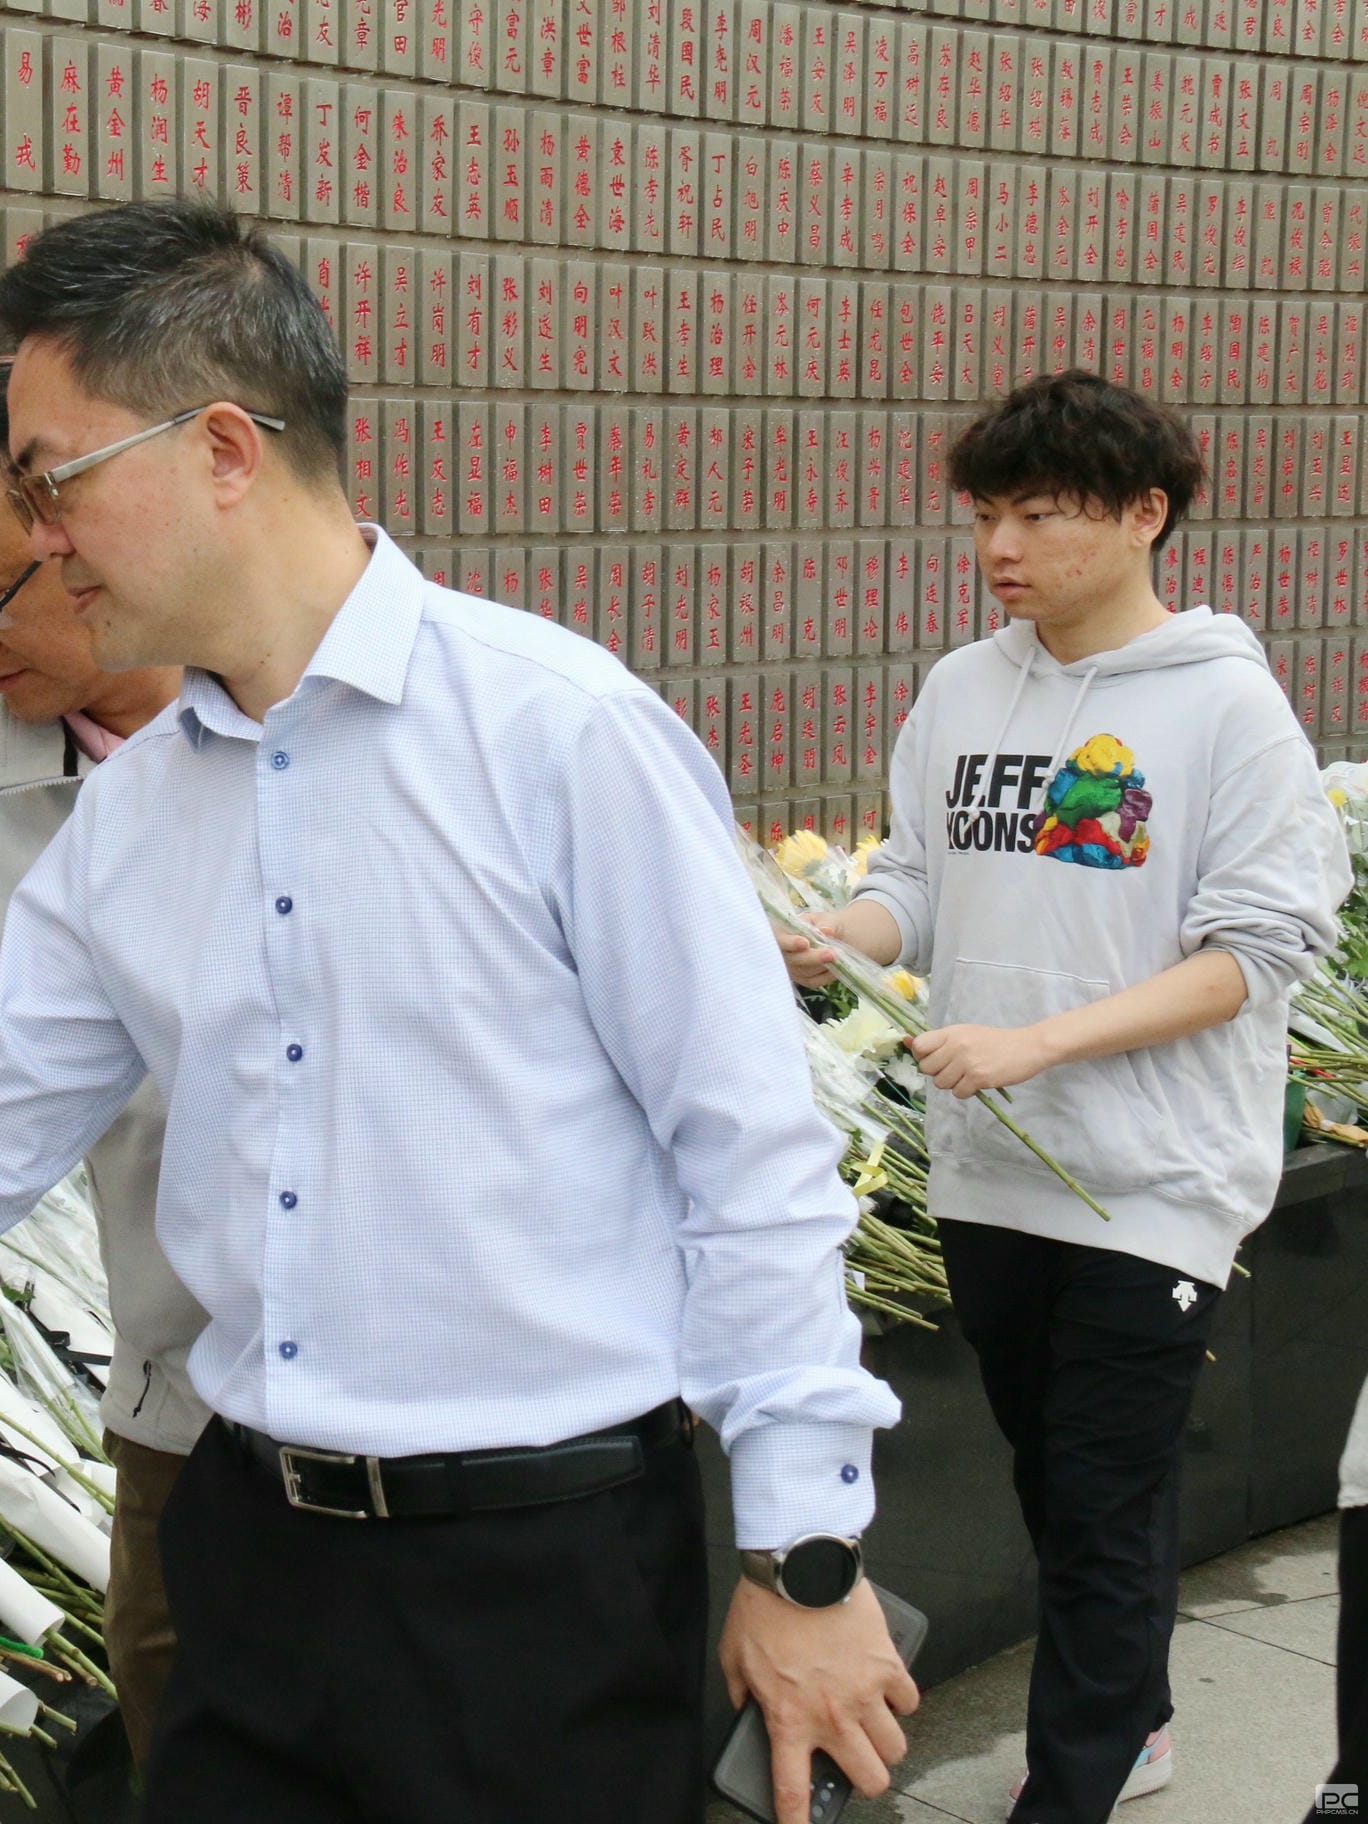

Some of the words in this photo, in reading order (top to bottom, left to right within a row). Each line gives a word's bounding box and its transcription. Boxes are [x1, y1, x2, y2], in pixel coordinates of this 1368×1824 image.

[61, 61, 82, 176] 麻在勤
[105, 66, 126, 180] 黄金州
[150, 74, 169, 183] 杨润生
[192, 80, 211, 189] 胡天才
[316, 104, 333, 205] 丁发新
[393, 111, 409, 214] 朱治良
[466, 124, 483, 220] 王志英
[354, 261, 372, 365] 许开祥
[393, 266, 409, 368] 吴立才
[467, 274, 482, 369] 刘有才
[354, 418, 373, 518] 张相文
[946, 754, 1053, 809] JEFF
